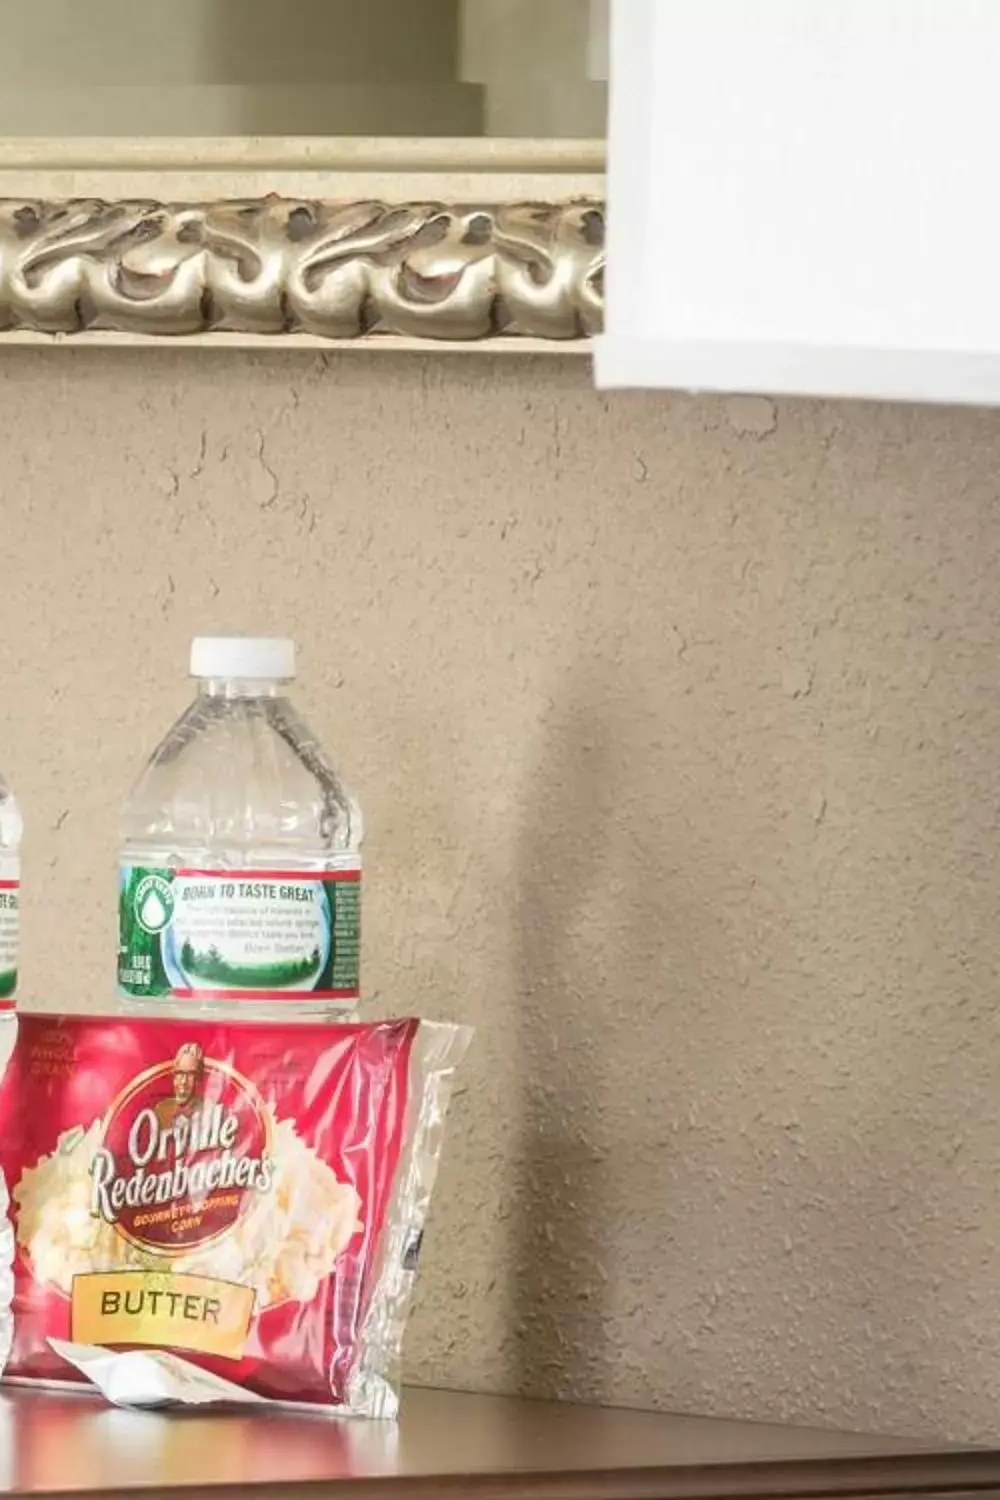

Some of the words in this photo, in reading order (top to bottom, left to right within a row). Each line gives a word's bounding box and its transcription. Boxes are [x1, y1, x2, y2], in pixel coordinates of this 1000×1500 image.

[181, 885, 216, 901] BORN
[219, 883, 236, 899] TO
[239, 883, 277, 899] TASTE
[279, 885, 314, 901] GREAT
[128, 1102, 239, 1167] Orville
[101, 1290, 222, 1324] BUTTER
